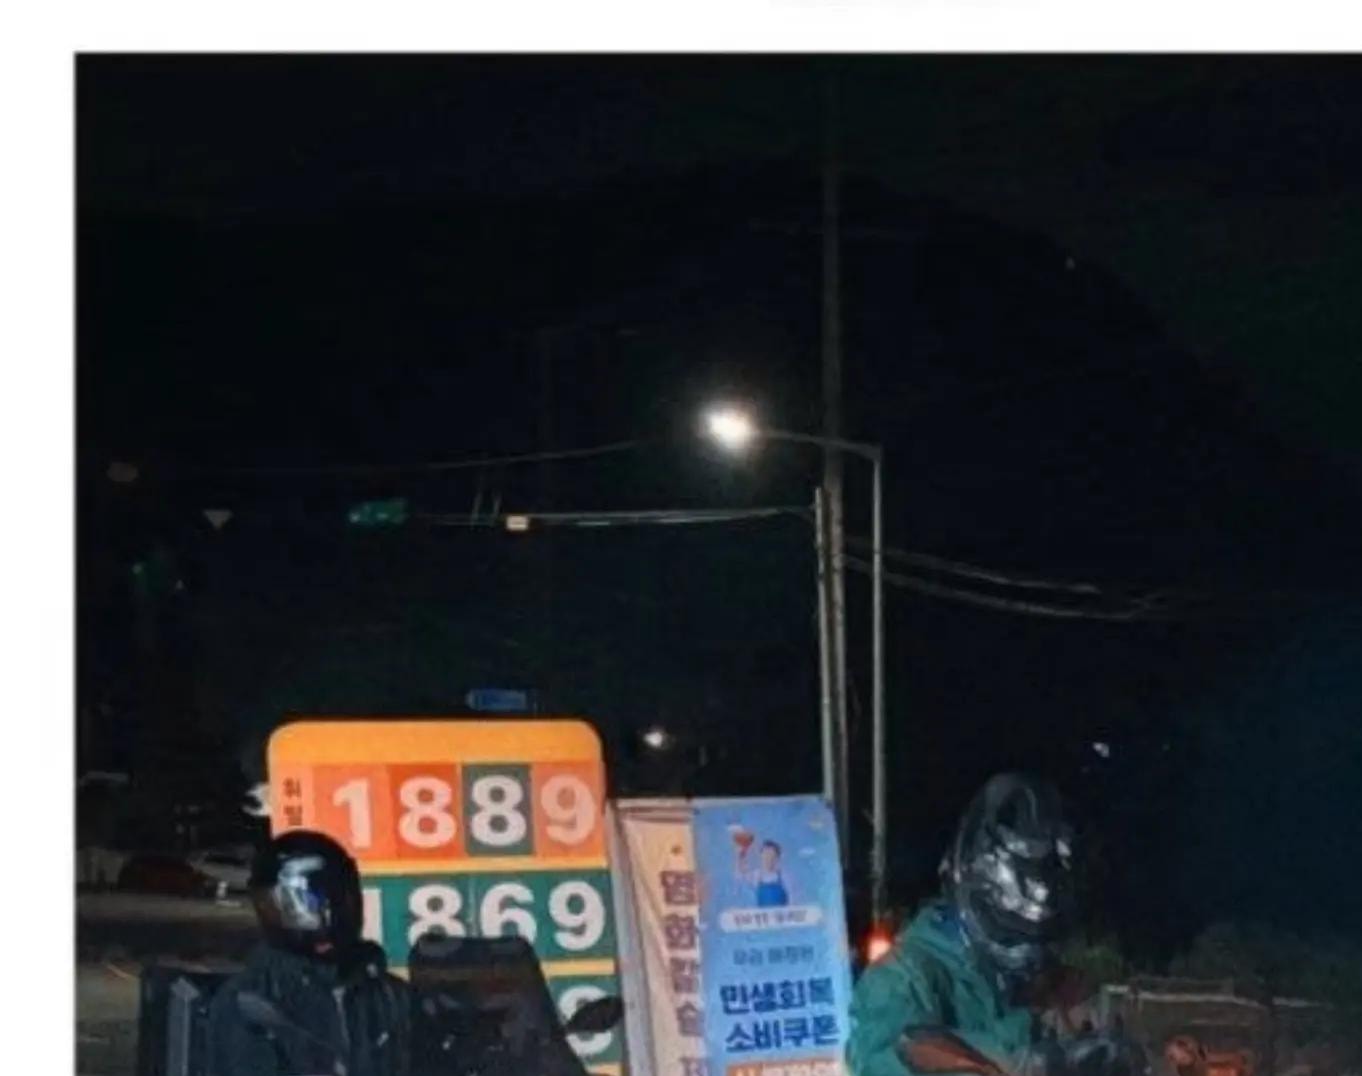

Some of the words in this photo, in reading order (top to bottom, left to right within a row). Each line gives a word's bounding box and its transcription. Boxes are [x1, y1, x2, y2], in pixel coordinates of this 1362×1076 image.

[333, 776, 597, 847] 1889
[362, 881, 606, 950] 1869
[720, 977, 834, 1014] 민생회복
[726, 1015, 840, 1052] 소비쿠폰
